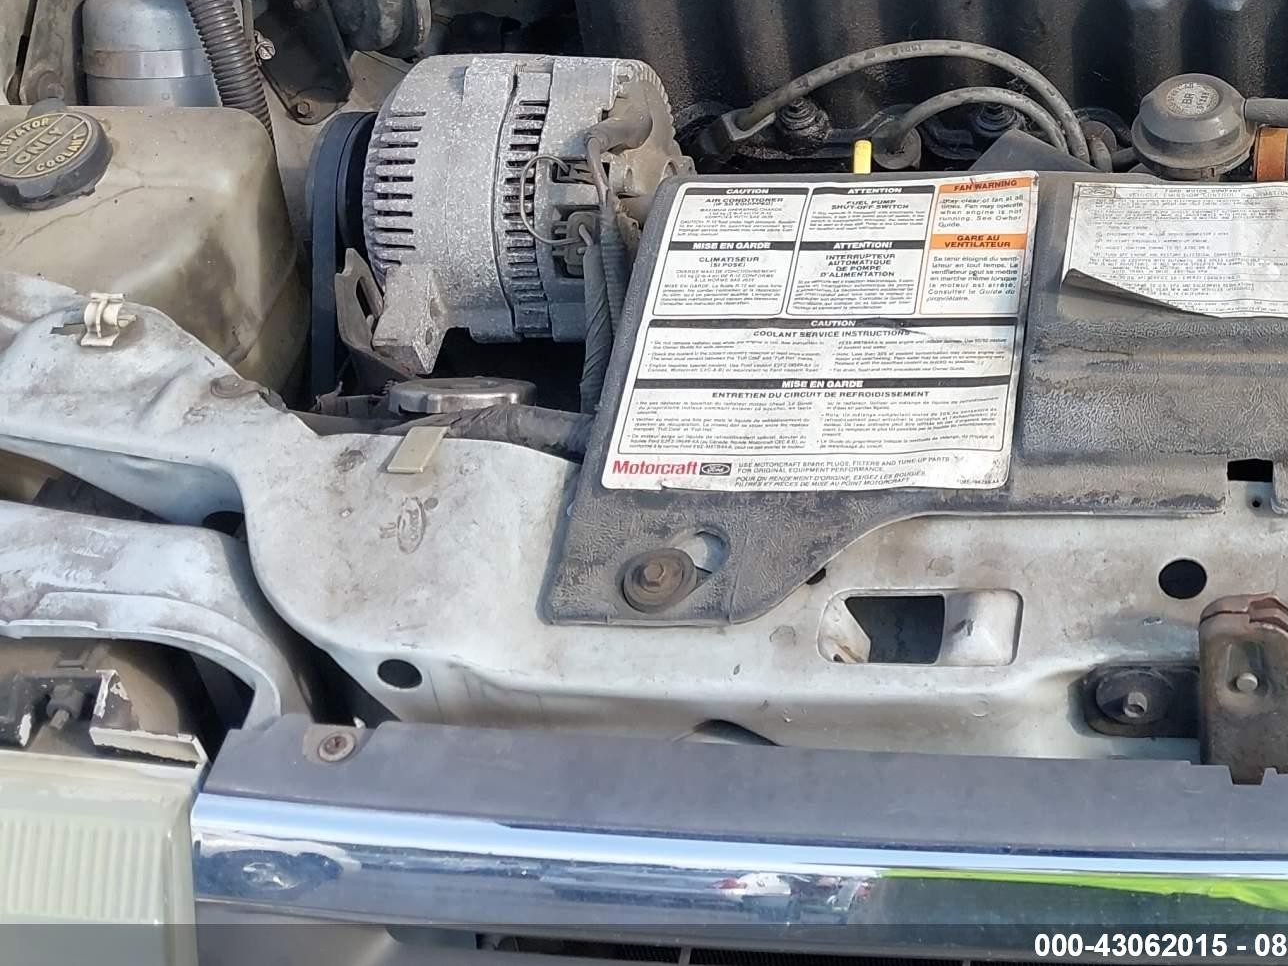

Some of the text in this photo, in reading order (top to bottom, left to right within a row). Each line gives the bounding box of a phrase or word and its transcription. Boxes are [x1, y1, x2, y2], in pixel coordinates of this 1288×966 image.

[14, 127, 63, 164] ONLY
[36, 132, 86, 171] COOLANT
[974, 179, 1017, 190] WARNING
[833, 242, 893, 250] ATTENTION!
[782, 380, 864, 388] MISE EN GARDE
[612, 460, 699, 475] Motorcraft
